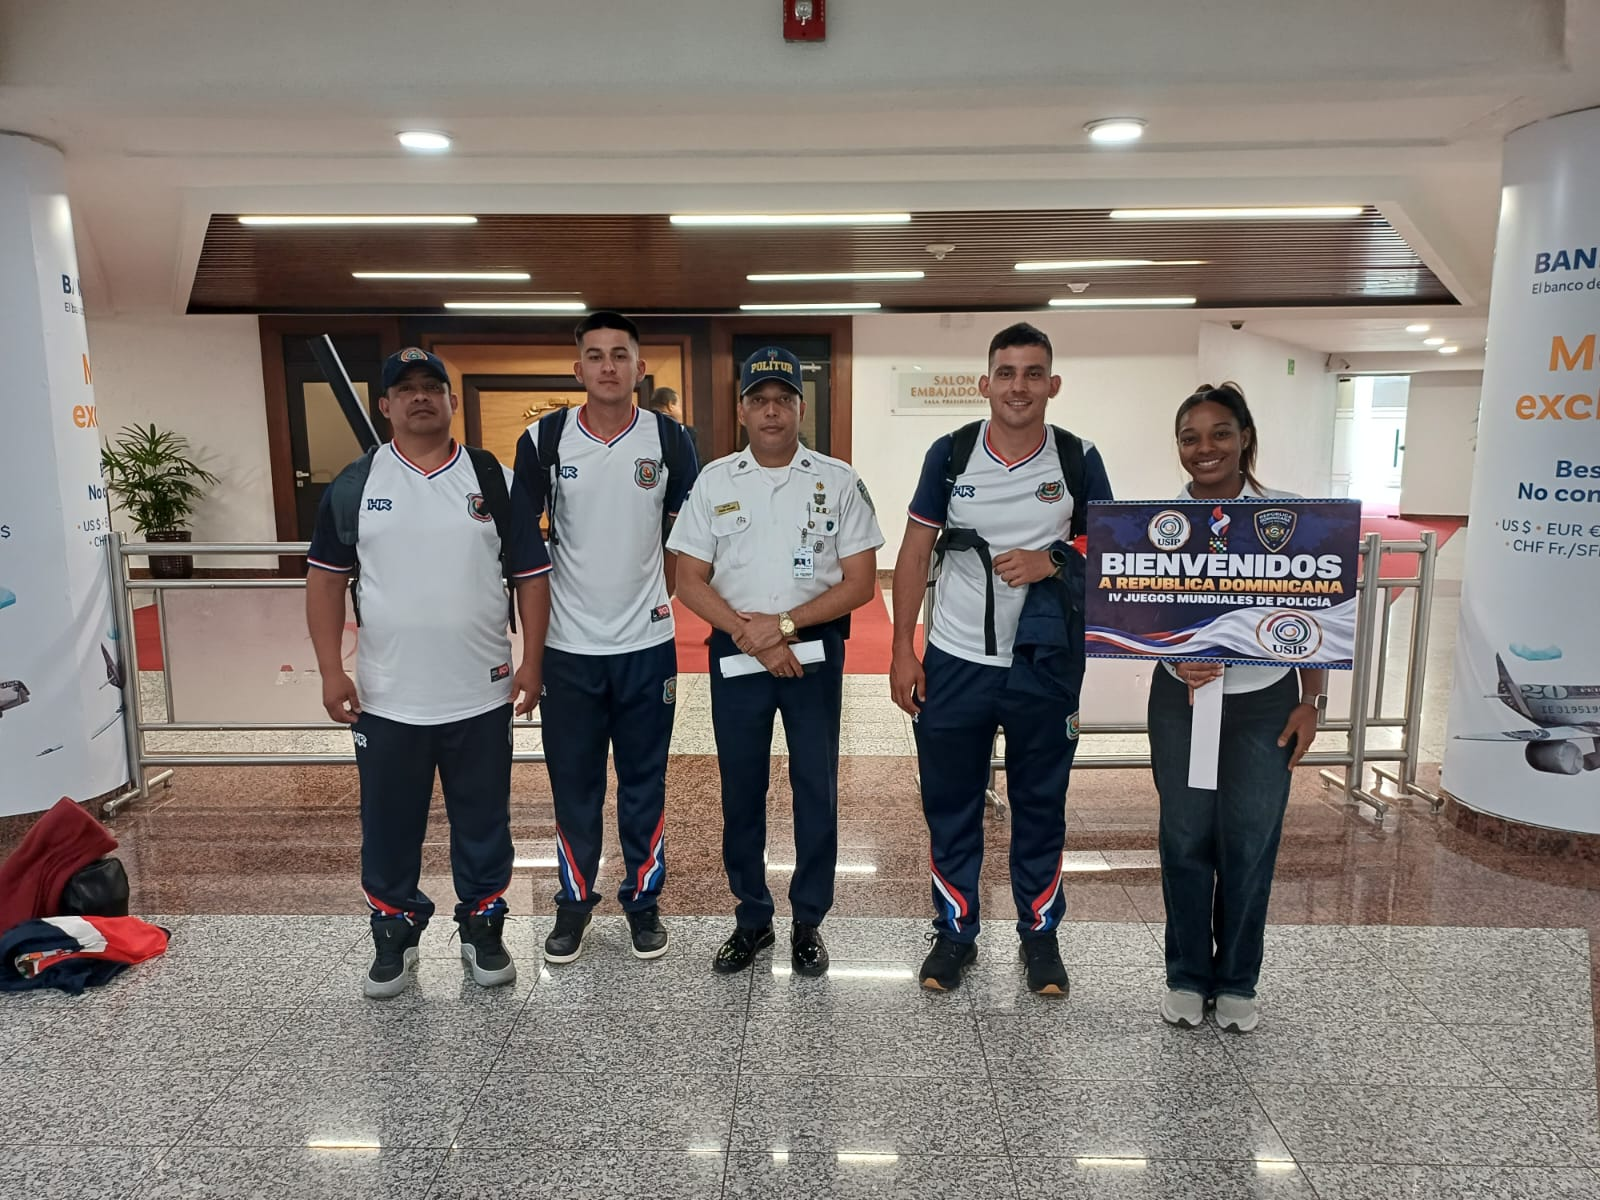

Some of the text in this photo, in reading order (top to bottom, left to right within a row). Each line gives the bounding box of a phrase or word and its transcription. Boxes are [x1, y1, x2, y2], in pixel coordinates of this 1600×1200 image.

[1534, 247, 1600, 274] BAN
[1532, 283, 1542, 294] El
[1544, 281, 1584, 293] banco
[1549, 334, 1600, 372] M
[751, 360, 793, 374] POLITUR
[934, 376, 976, 386] SALON
[73, 404, 98, 428] ex
[88, 484, 102, 500] No
[1518, 482, 1548, 501] No
[367, 499, 393, 511] HR
[1502, 519, 1600, 538] US $ EUR €
[1158, 538, 1181, 546] USIP
[1513, 540, 1544, 553] CHF
[1101, 553, 1342, 579] BIENVENIDOS
[1099, 577, 1112, 589] A
[1219, 578, 1344, 594] DOMINICANA
[1109, 593, 1331, 607] IV JUEGOS MUNDIALES DE POLICÍA
[1272, 644, 1308, 655] USIP
